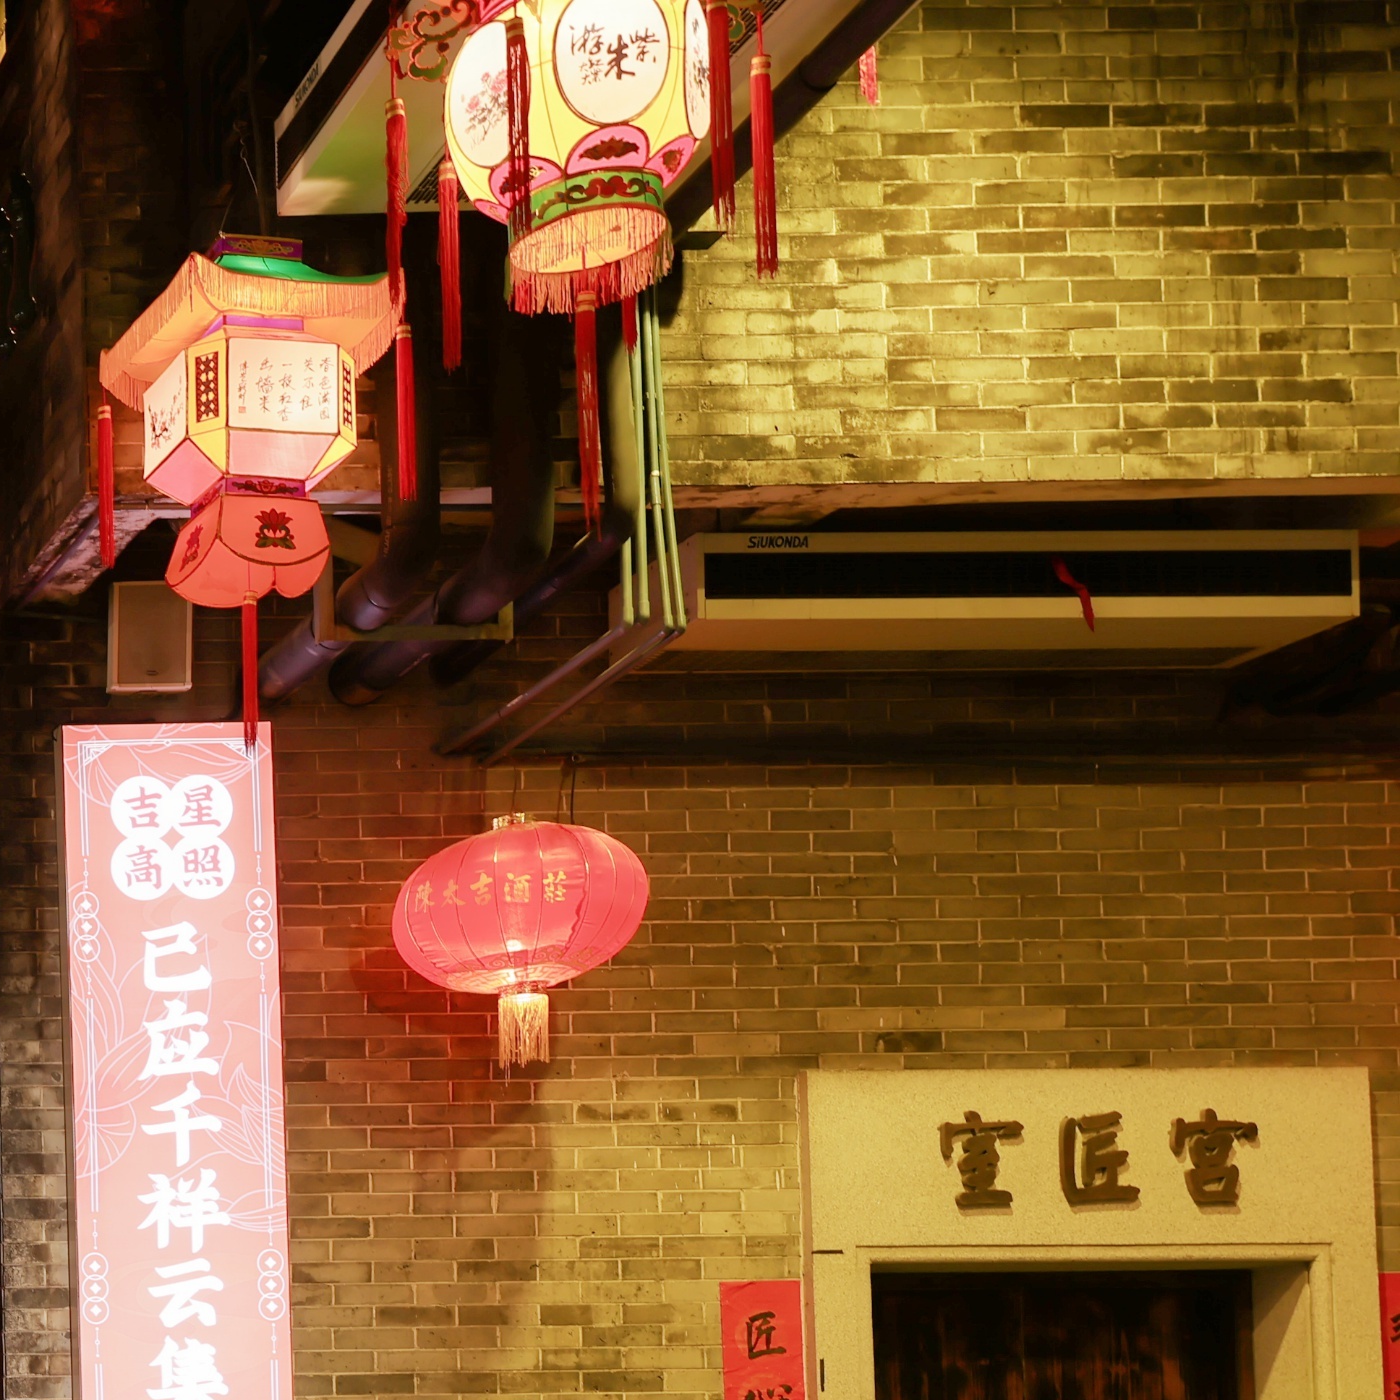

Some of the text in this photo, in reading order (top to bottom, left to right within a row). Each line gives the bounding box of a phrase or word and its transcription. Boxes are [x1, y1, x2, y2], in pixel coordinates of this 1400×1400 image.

[123, 784, 222, 829] 吉星
[125, 844, 224, 889] 高照
[414, 871, 567, 914] 陳太吉酒莊
